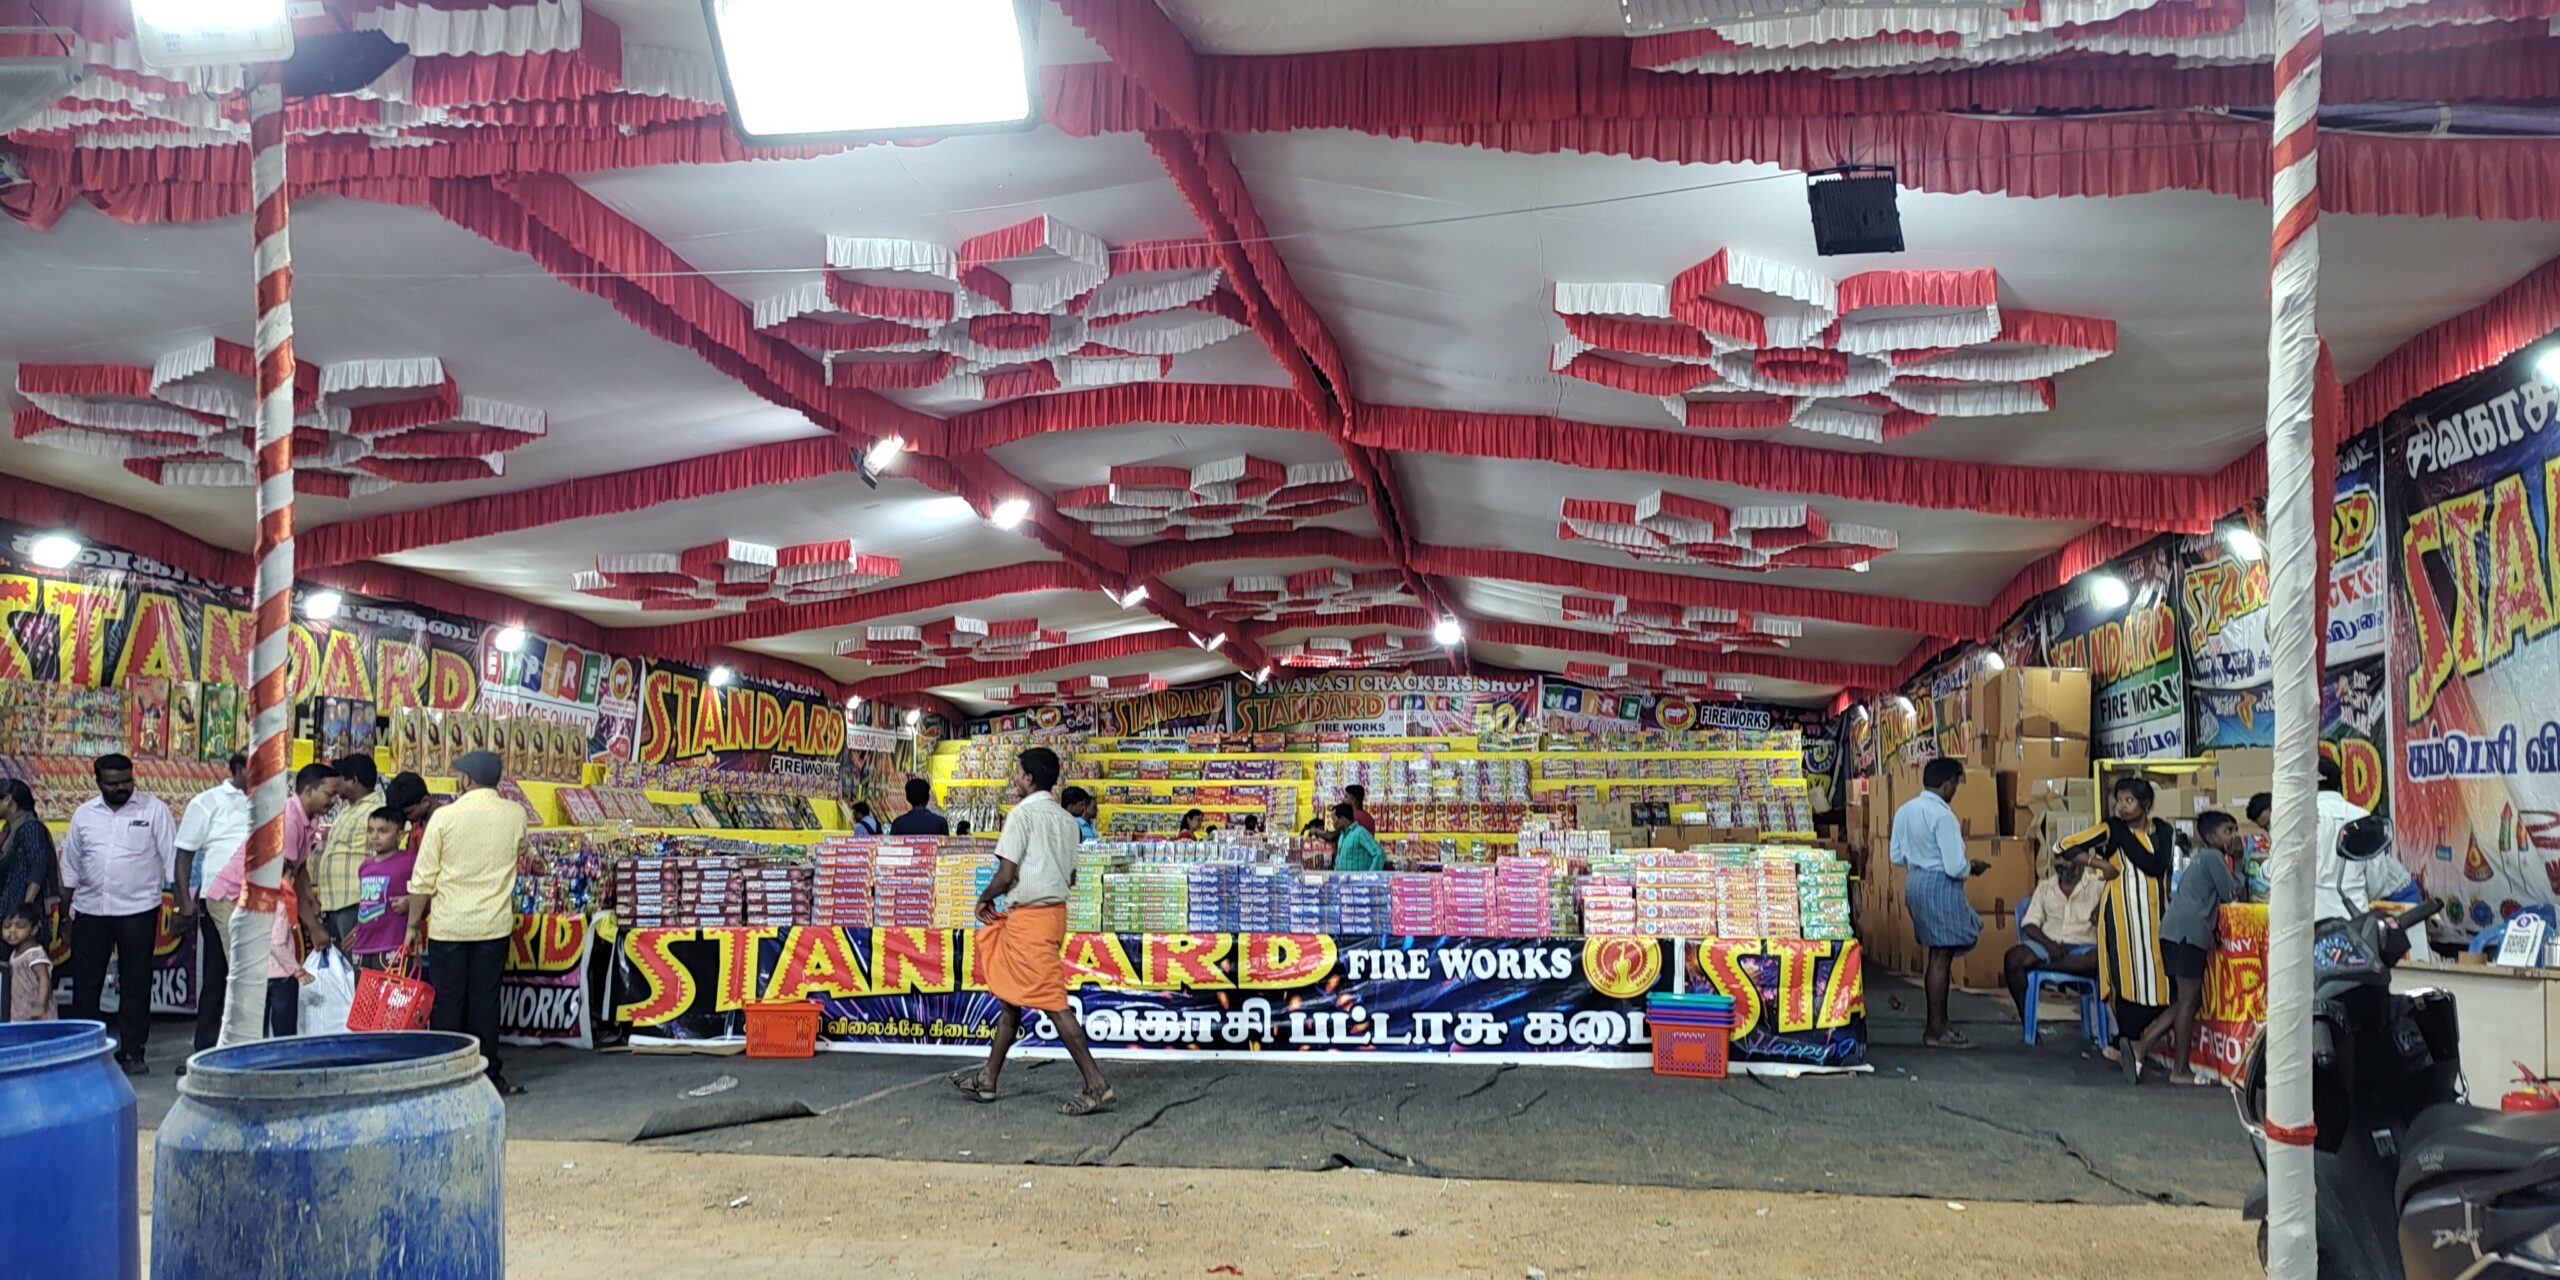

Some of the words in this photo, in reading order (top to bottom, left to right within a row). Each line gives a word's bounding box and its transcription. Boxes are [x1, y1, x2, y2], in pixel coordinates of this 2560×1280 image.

[1255, 675, 1355, 694] SIVAKASI
[1360, 675, 1473, 692] CRACKERS
[1478, 676, 1535, 693] SHOP
[640, 670, 844, 764] STANDARD
[1115, 682, 1225, 738] STANDARD
[1237, 695, 1385, 735] STANDARD
[1702, 706, 1727, 723] FIRE
[1729, 709, 1770, 728] WORKS
[2101, 693, 2128, 723] FIRE
[1315, 723, 1339, 732] FIRE
[1343, 722, 1385, 732] WORKS
[770, 757, 800, 773] FIRE
[803, 759, 841, 778] WORKS
[1347, 949, 1430, 980] FIRE
[1437, 948, 1572, 979] WORKS
[828, 1016, 924, 1038] விலைக்கே
[1289, 1005, 1507, 1045] பட்டாசு
